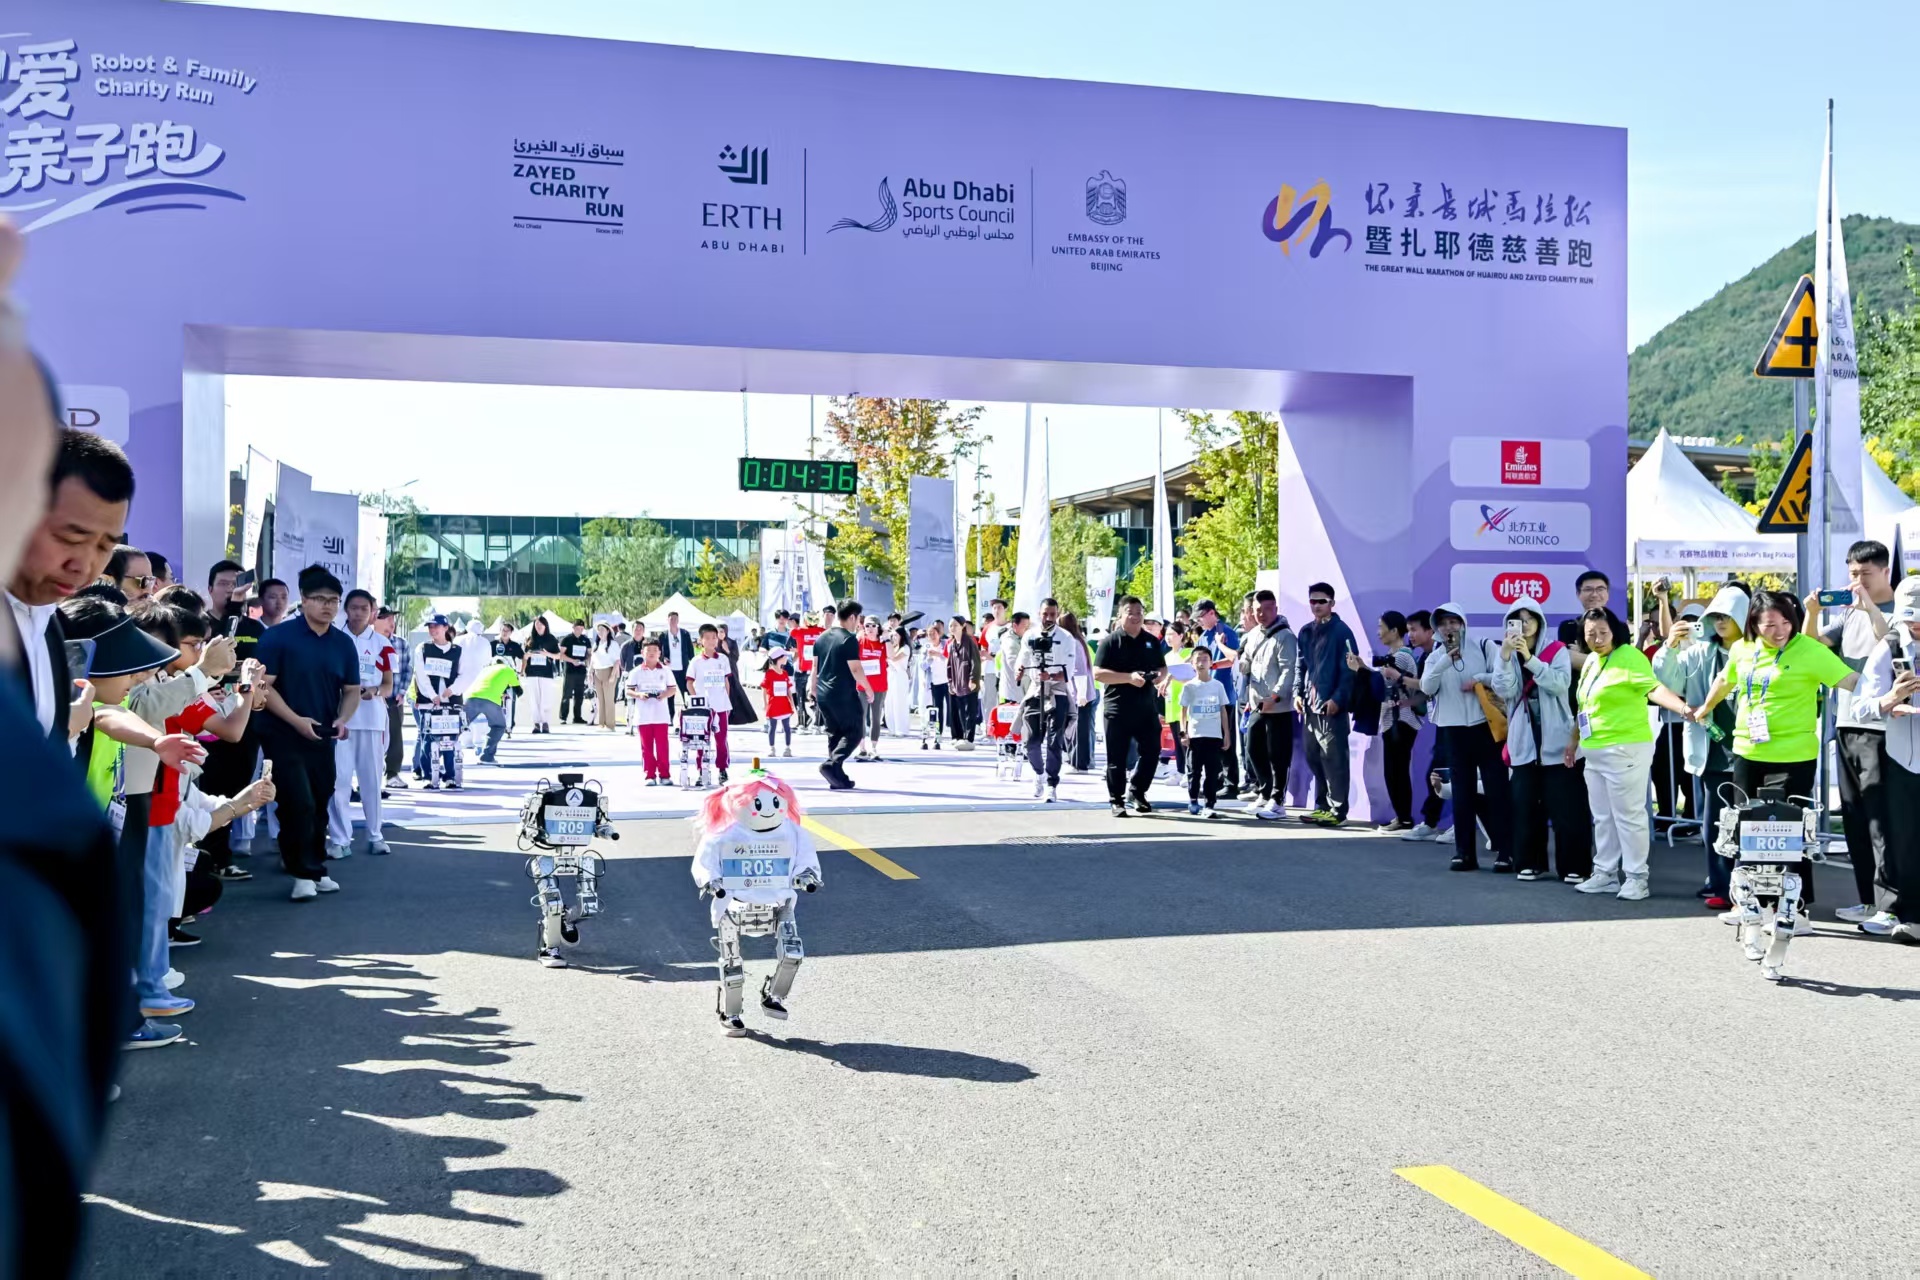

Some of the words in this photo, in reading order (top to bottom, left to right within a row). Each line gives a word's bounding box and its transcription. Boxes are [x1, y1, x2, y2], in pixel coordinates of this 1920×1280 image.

[0, 39, 79, 118] 爱
[91, 53, 156, 72] Robot
[163, 56, 179, 74] &
[187, 58, 257, 93] Family
[95, 78, 169, 102] Charity
[176, 81, 214, 105] Run
[0, 120, 223, 192] 亲子跑
[560, 142, 585, 158] زايد
[588, 144, 624, 160] سباق
[513, 163, 576, 181] ZAYED
[529, 181, 610, 200] CHARITY
[903, 177, 946, 199] Abu
[953, 180, 1015, 204] Dhabi
[585, 201, 624, 218] RUN
[702, 202, 782, 231] ERTH
[902, 201, 954, 222] Sports
[958, 204, 1015, 224] Council
[902, 224, 940, 239] الرياضي
[983, 228, 1015, 241] مجلس
[1067, 232, 1110, 244] EMBASSY
[1111, 235, 1125, 245] OF
[1126, 236, 1145, 246] THE
[700, 240, 730, 251] ABU
[738, 241, 784, 254] DHABI
[1051, 245, 1087, 256] UNITED
[1088, 247, 1115, 258] ARAB
[1116, 249, 1161, 260] EMIRATES
[1365, 224, 1593, 269] 暨扎耶德慈善跑
[1090, 261, 1123, 272] BEIJING
[1365, 263, 1379, 272] THE
[1380, 264, 1404, 273] GREAT
[1405, 266, 1425, 275] WALL
[1426, 267, 1465, 277] MARATHON
[1466, 270, 1476, 278] OF
[1476, 271, 1508, 280] HUAIROU
[1509, 273, 1524, 281] AND
[1525, 274, 1547, 282] ZAYED
[1548, 275, 1578, 284] CHARITY
[1579, 277, 1594, 285] RUN
[1504, 462, 1538, 472] Emirates
[743, 461, 854, 491] 0:04:36
[1508, 521, 1548, 532] 北方工业
[1508, 535, 1560, 546] NORINCO
[1499, 579, 1543, 598] 小红书
[558, 821, 585, 834] R09
[1756, 836, 1787, 850] R06
[741, 859, 774, 876] R05
